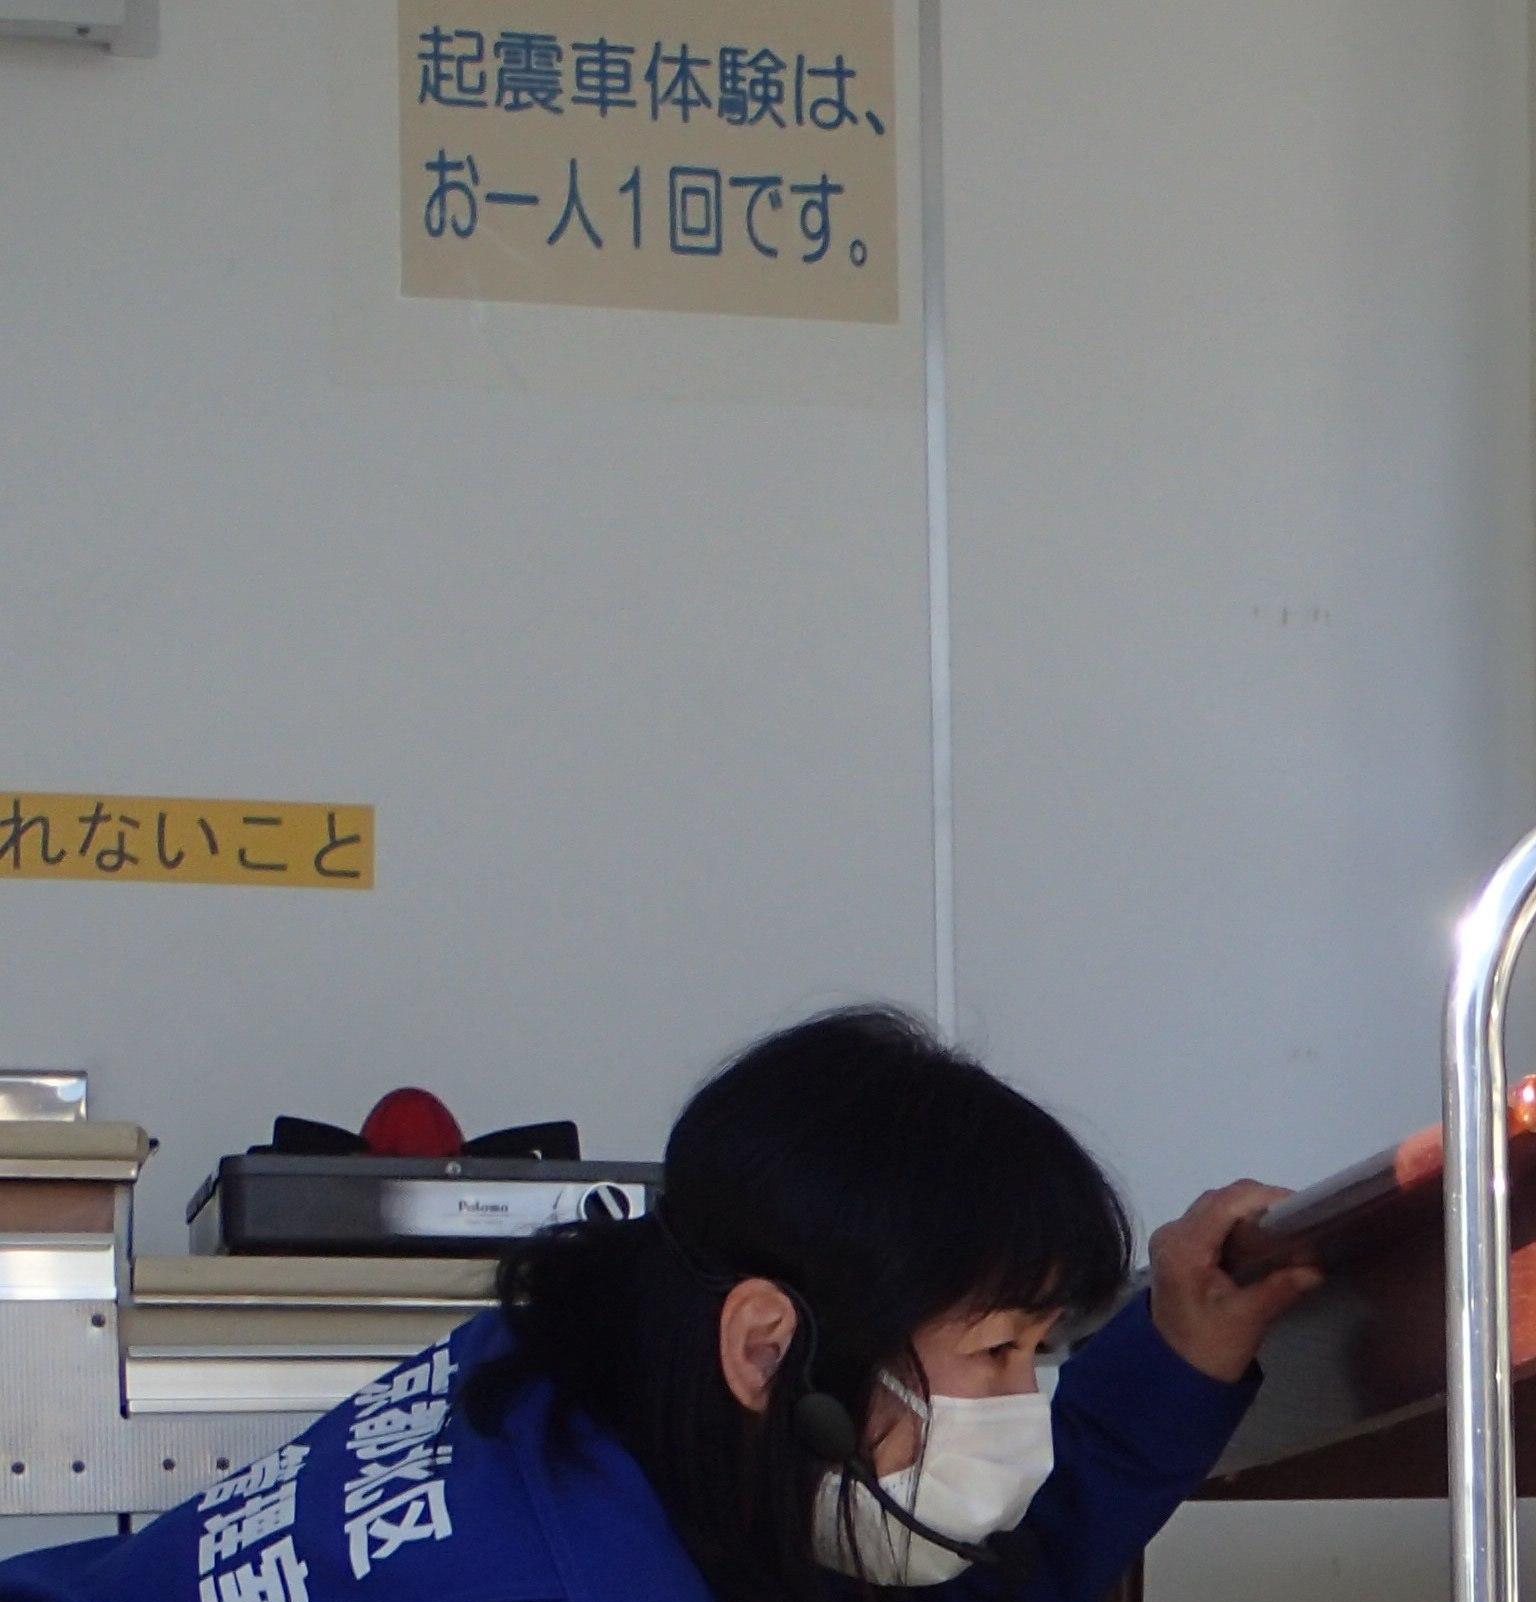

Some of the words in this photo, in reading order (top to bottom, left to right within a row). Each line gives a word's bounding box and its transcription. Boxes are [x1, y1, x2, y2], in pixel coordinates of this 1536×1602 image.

[417, 25, 888, 137] 起震車体験は、
[424, 148, 869, 268] お一人1回です。
[0, 798, 361, 878] れないこと
[344, 1333, 458, 1581] 京都北区
